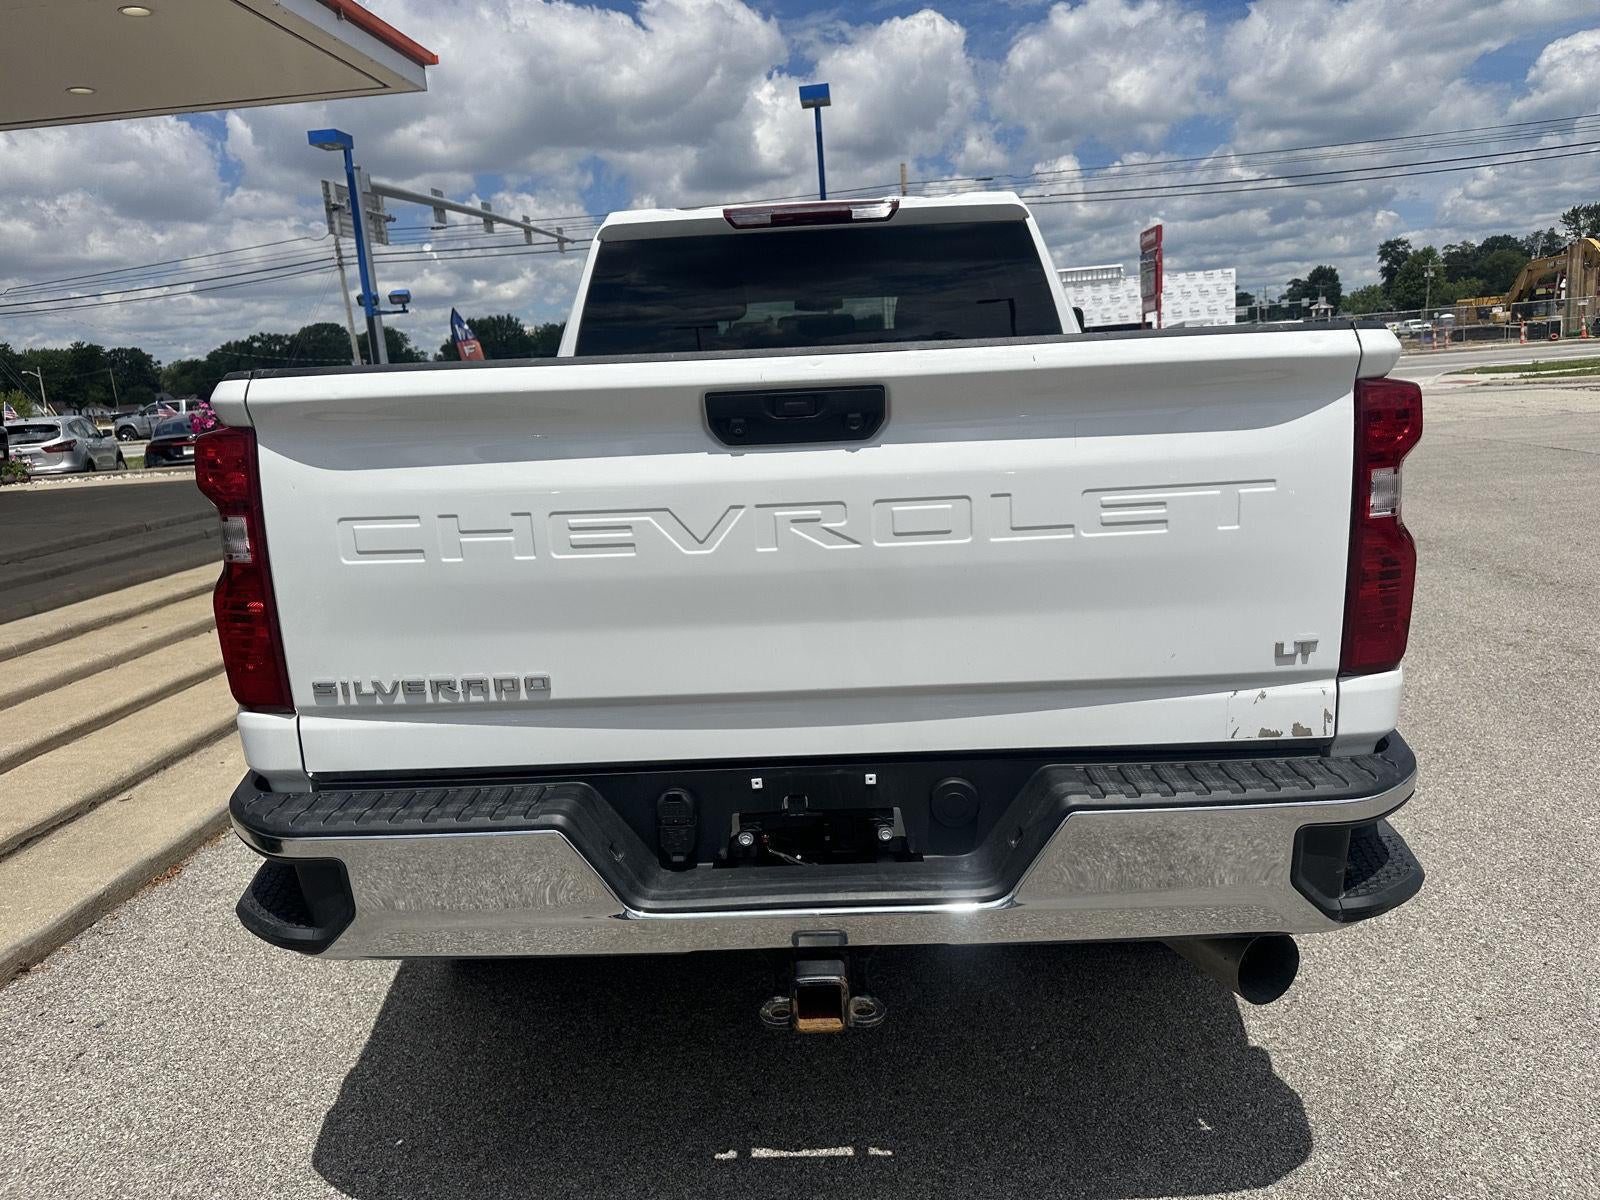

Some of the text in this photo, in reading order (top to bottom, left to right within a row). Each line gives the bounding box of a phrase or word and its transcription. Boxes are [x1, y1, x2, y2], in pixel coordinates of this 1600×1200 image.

[337, 478, 1277, 565] CHEVROLET
[1274, 639, 1319, 666] LT
[311, 674, 552, 702] SILVERADO
